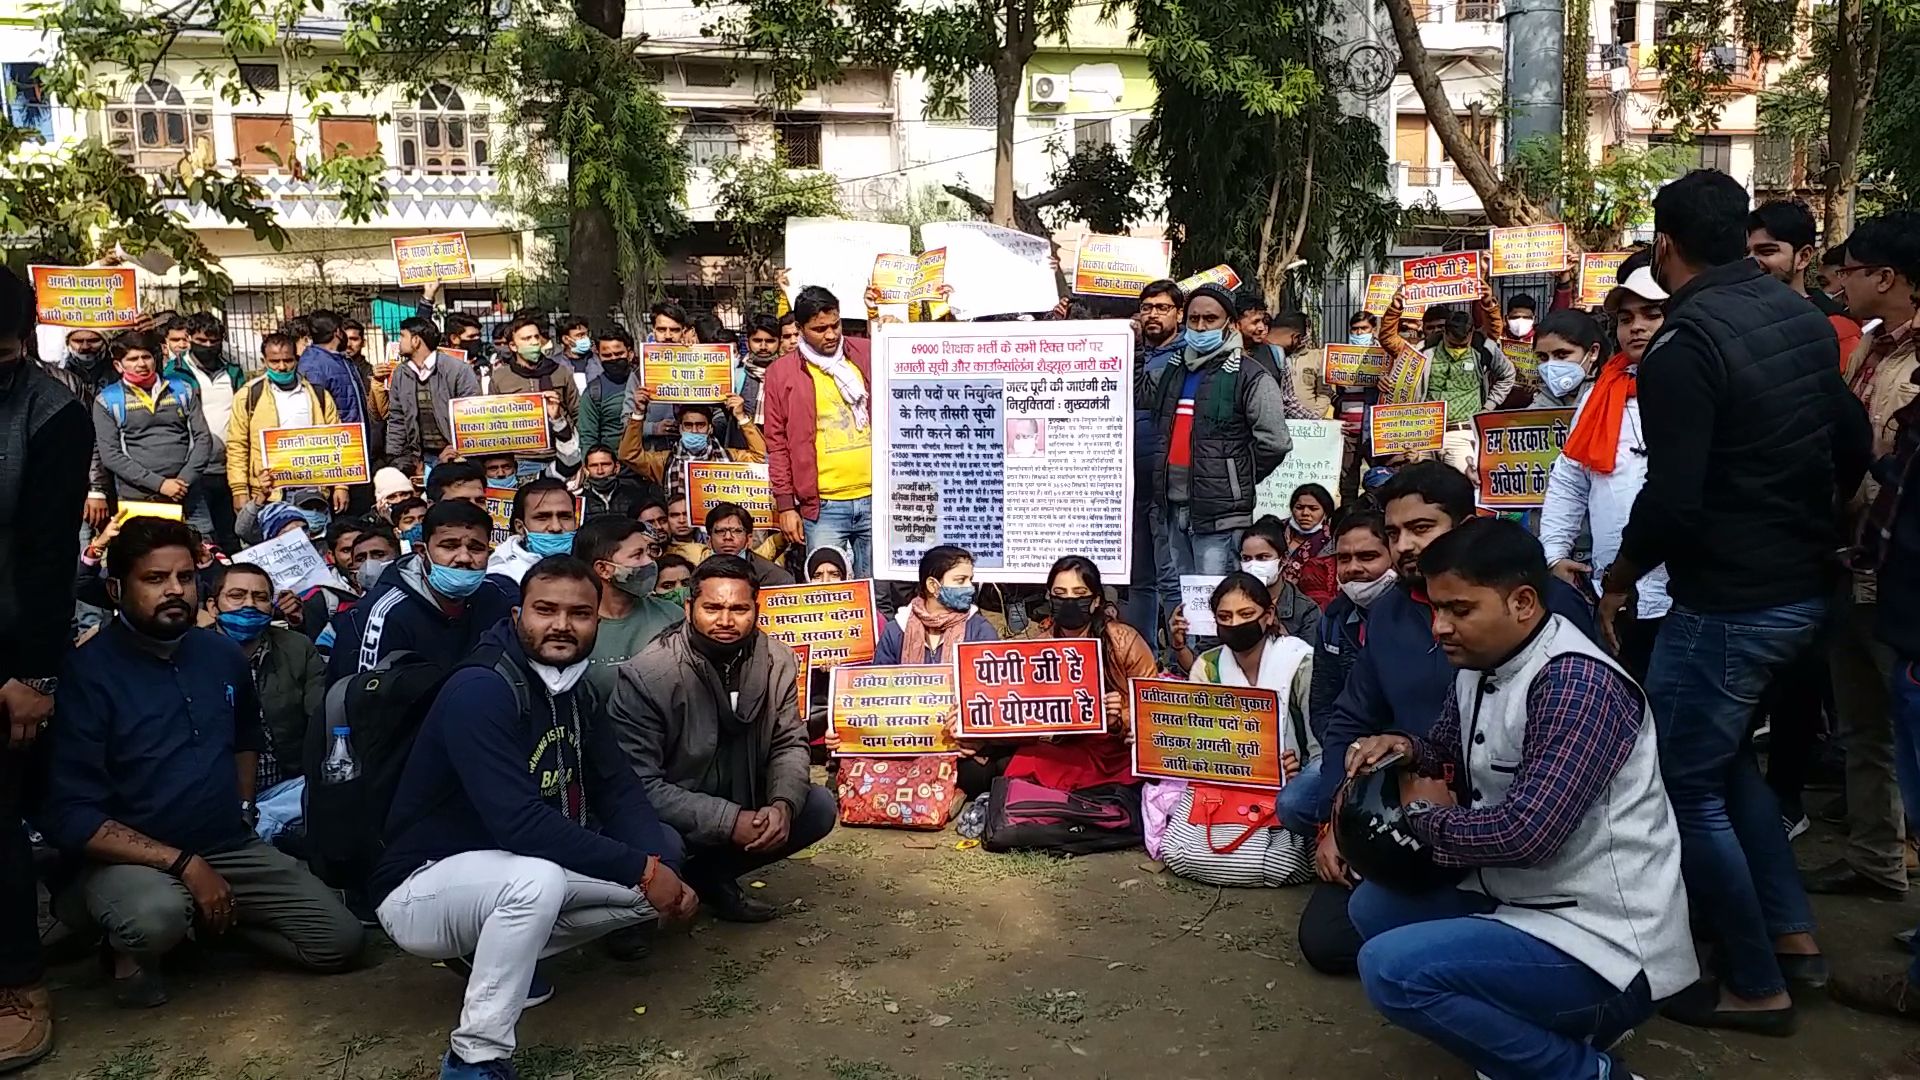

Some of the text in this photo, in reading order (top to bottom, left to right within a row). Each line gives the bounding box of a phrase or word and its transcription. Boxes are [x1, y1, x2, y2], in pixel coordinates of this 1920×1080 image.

[1412, 257, 1468, 278] योगी जी है
[1409, 284, 1421, 300] तो
[1426, 283, 1462, 297] योग्यता
[1465, 279, 1474, 294] है
[911, 338, 1104, 354] 69000 शिक्षक भर्ती के सभी रिक्त पदों पर
[649, 349, 726, 362] हम भी मानक
[681, 369, 695, 380] पास
[893, 358, 925, 373] अगली
[928, 358, 949, 376] सूची
[951, 359, 971, 372] और
[1073, 357, 1096, 371] जारी
[891, 384, 1004, 404] खाली पदों पर नियुक्ति
[1006, 376, 1118, 396] जल्द पूरी की जाएंगी शेष
[1006, 396, 1055, 414] नियुक्तियां
[1064, 395, 1111, 414] मुख्यमंत्री
[899, 404, 996, 424] के लिए तीसरी सूची
[460, 422, 485, 432] सरकार
[899, 424, 995, 439] जारी करने की मांग
[278, 432, 350, 449] अगली चयन सूची
[1485, 419, 1567, 453] हम सरकार के
[291, 456, 305, 467] तय
[308, 454, 330, 465] समय
[273, 464, 362, 481] जारी करो जारी करो
[693, 469, 730, 479] हम सब
[1531, 463, 1546, 494] के
[703, 483, 717, 494] की
[721, 484, 741, 494] यही
[759, 613, 769, 626] से
[801, 625, 862, 642] सरकार में
[811, 646, 849, 660] लगेगा
[975, 649, 1083, 684] योगी जी है
[842, 694, 853, 707] से
[968, 690, 1094, 726] तो योग्यता है
[1140, 687, 1272, 713] प्रतीक्षारत की यही पुकार
[846, 713, 930, 727] योगी सरकार
[1151, 711, 1260, 733] समस्त रिक्त पदों को
[861, 733, 935, 747] दाग लगेगा
[1152, 731, 1260, 759] जोड़कर अगली सूची
[1162, 756, 1188, 772] जारी
[1213, 762, 1252, 778] सरकार
